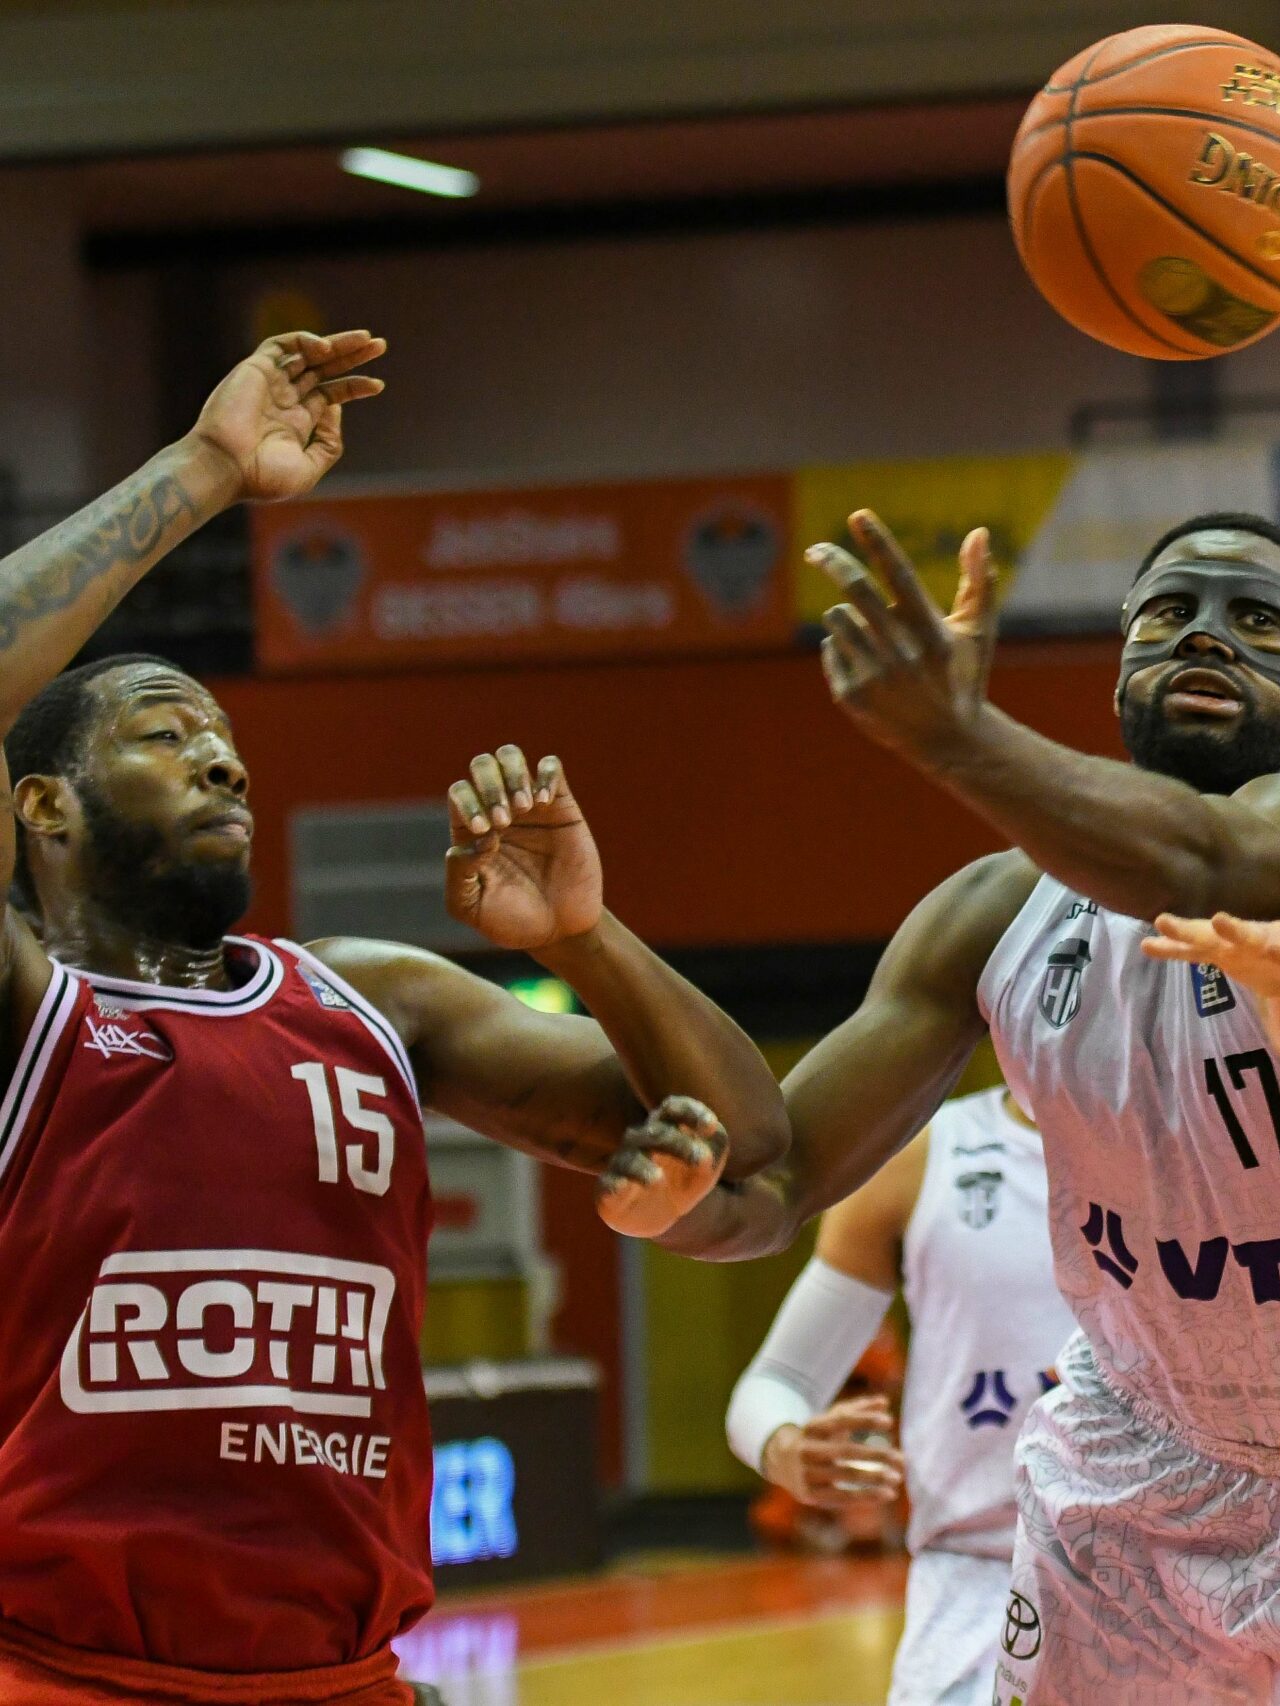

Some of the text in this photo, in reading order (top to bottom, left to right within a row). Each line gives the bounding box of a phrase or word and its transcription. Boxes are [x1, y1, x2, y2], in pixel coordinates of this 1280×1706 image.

[290, 1062, 396, 1197] 15
[89, 1279, 367, 1390] ROTH
[219, 1422, 391, 1480] ENERGIE
